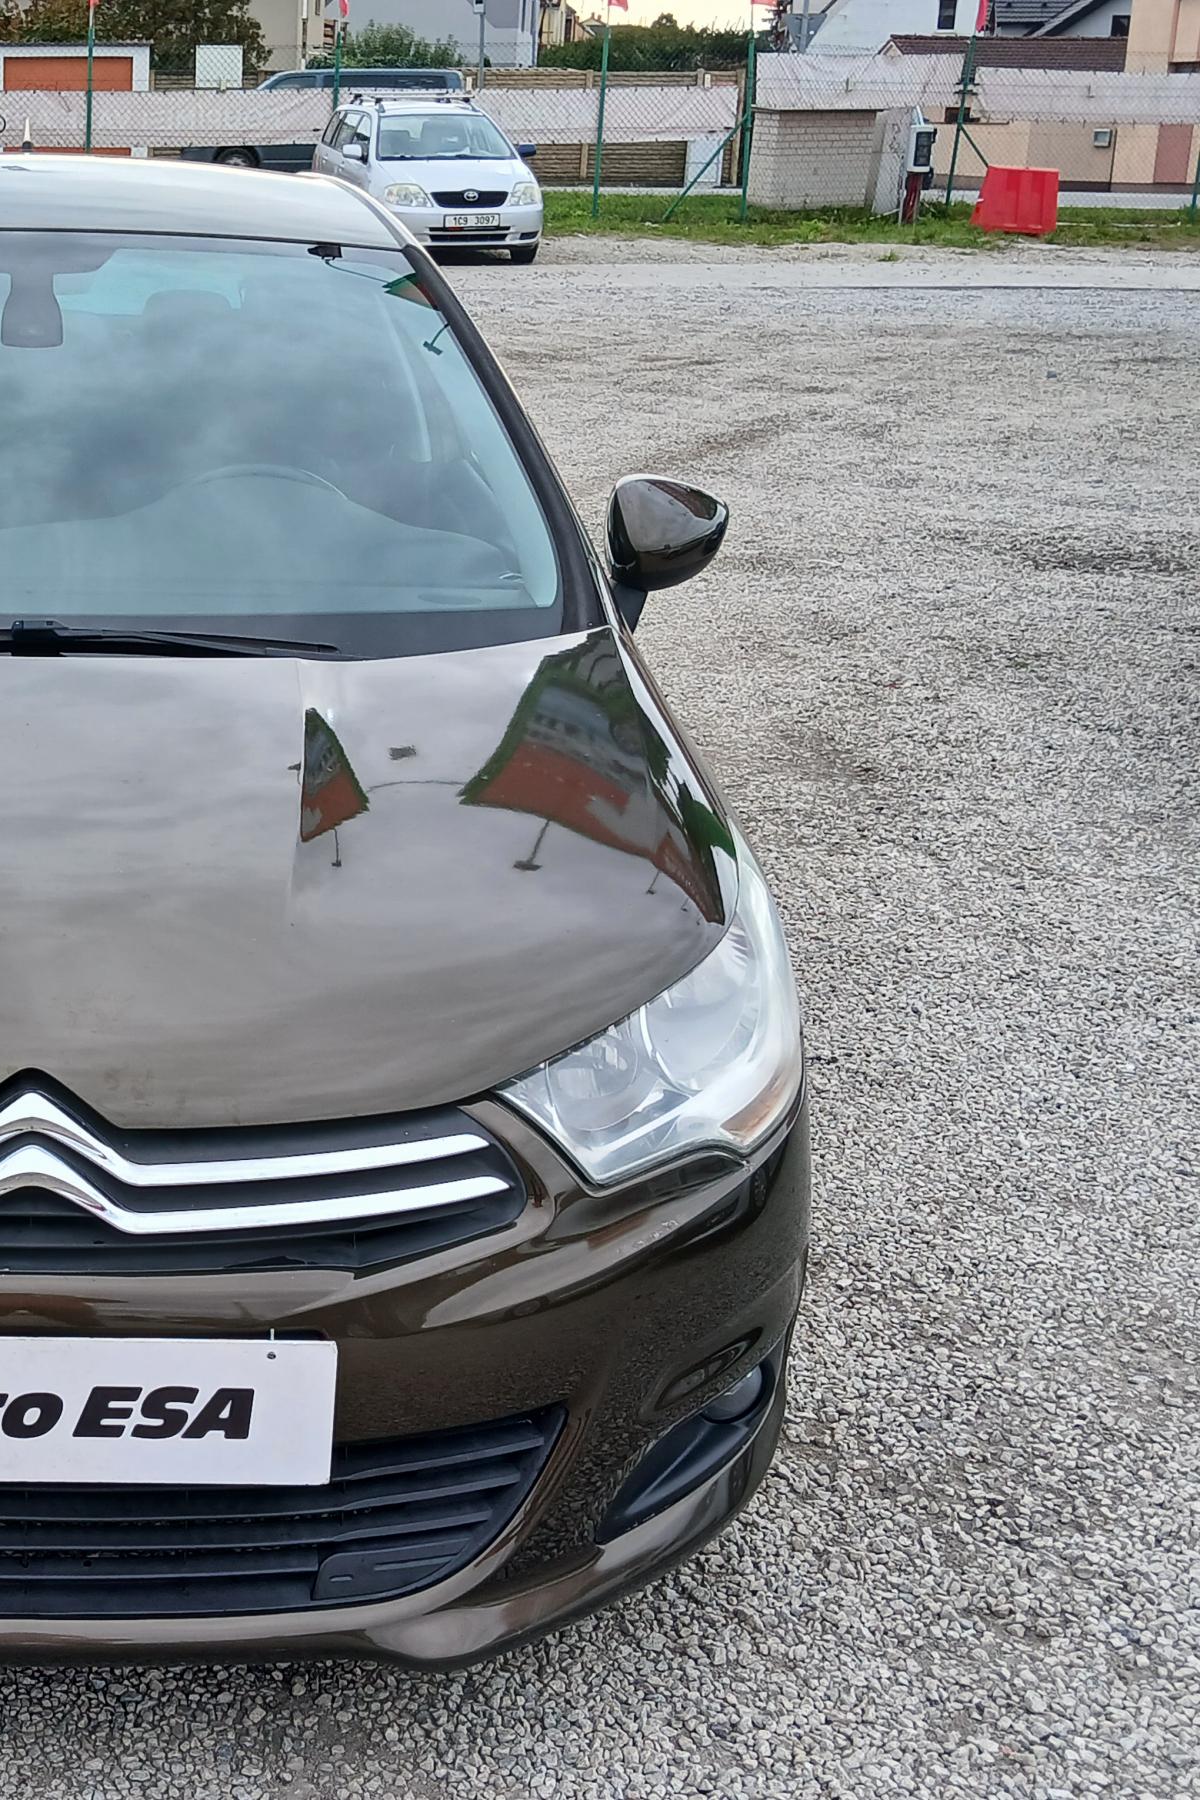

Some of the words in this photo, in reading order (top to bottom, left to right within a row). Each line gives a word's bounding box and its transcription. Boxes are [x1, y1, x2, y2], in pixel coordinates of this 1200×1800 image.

[453, 216, 468, 226] 1C9
[474, 215, 496, 225] 3097
[71, 1385, 256, 1440] ESA
